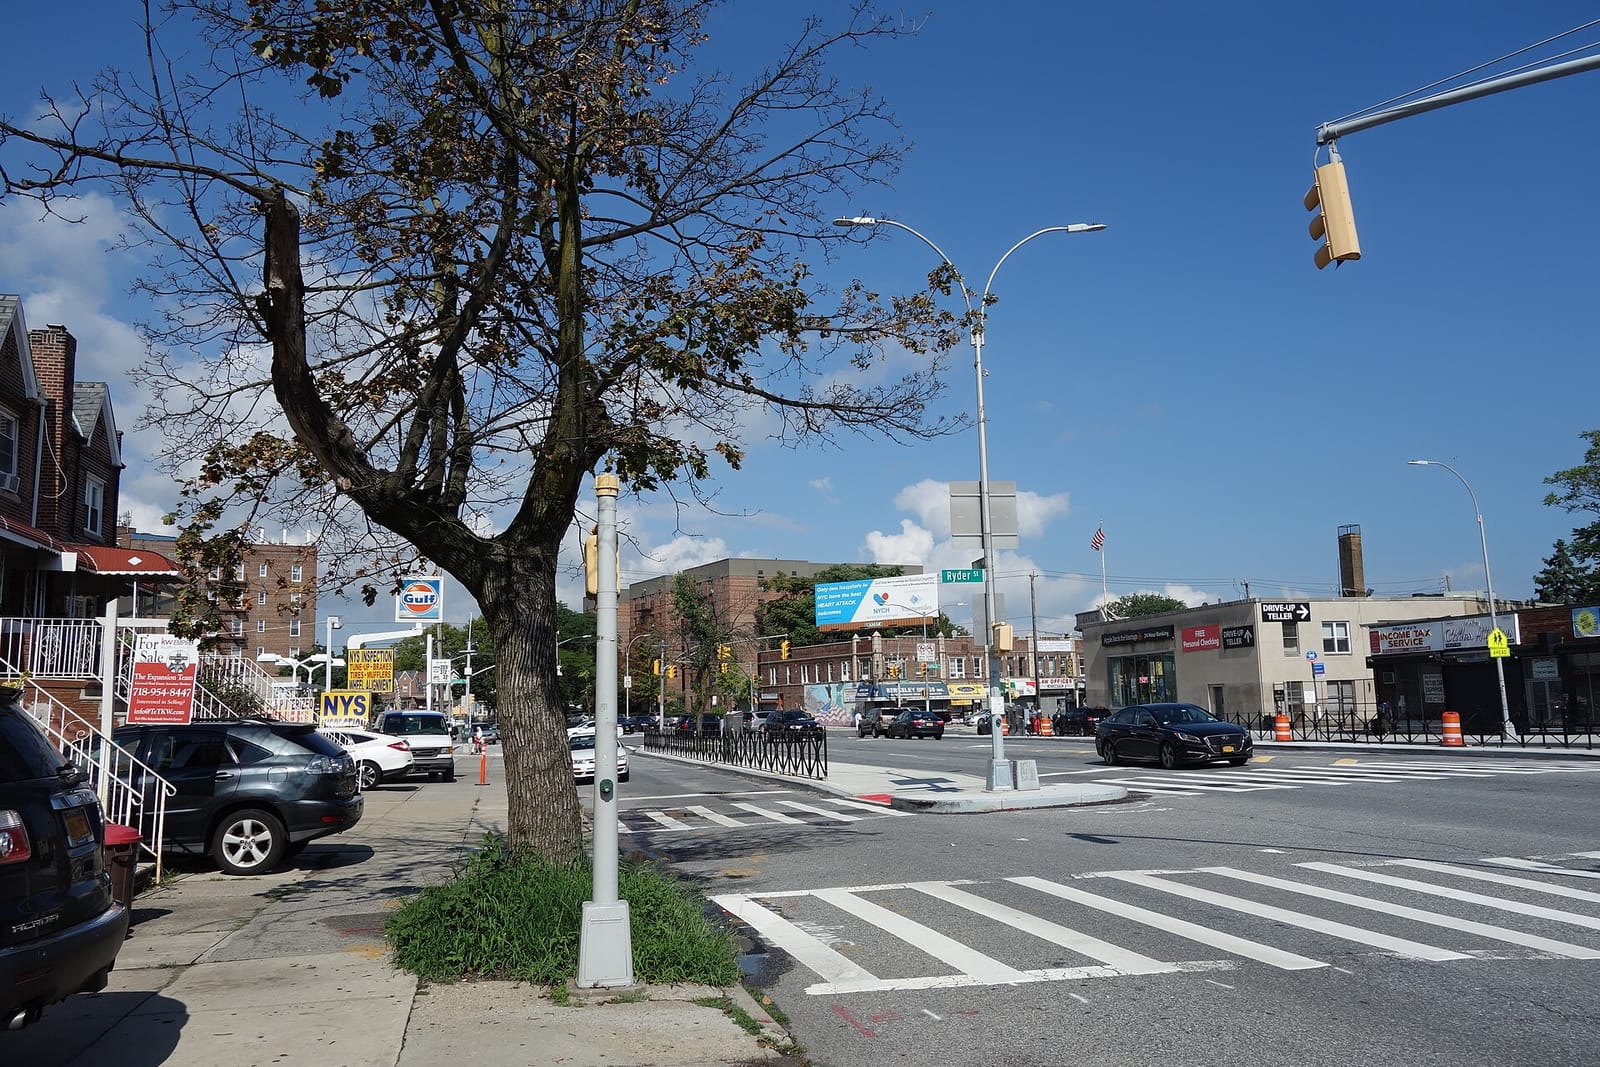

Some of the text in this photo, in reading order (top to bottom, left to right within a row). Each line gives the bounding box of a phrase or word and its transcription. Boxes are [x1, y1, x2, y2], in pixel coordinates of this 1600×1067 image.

[946, 570, 971, 582] Ryder
[403, 593, 436, 604] Gulf
[1262, 604, 1296, 612] DRIVE-UP
[1267, 612, 1293, 620] TELLER
[1194, 629, 1206, 637] FREE
[1223, 629, 1244, 638] DRIVE-UP
[1380, 629, 1431, 641] INCOME TAX
[139, 636, 159, 649] For
[1183, 637, 1219, 648] Personal Checking
[1226, 637, 1242, 645] TELLER
[1388, 637, 1424, 648] SERVICE
[140, 650, 164, 662] Sale
[349, 650, 392, 662] NYS INSPECTION
[147, 673, 177, 681] Expansion
[350, 679, 391, 690] WHEEL ALIGNMENT
[132, 687, 192, 697] 718-954-8447
[323, 695, 366, 717] NYS
[12, 913, 59, 933] ACURA
